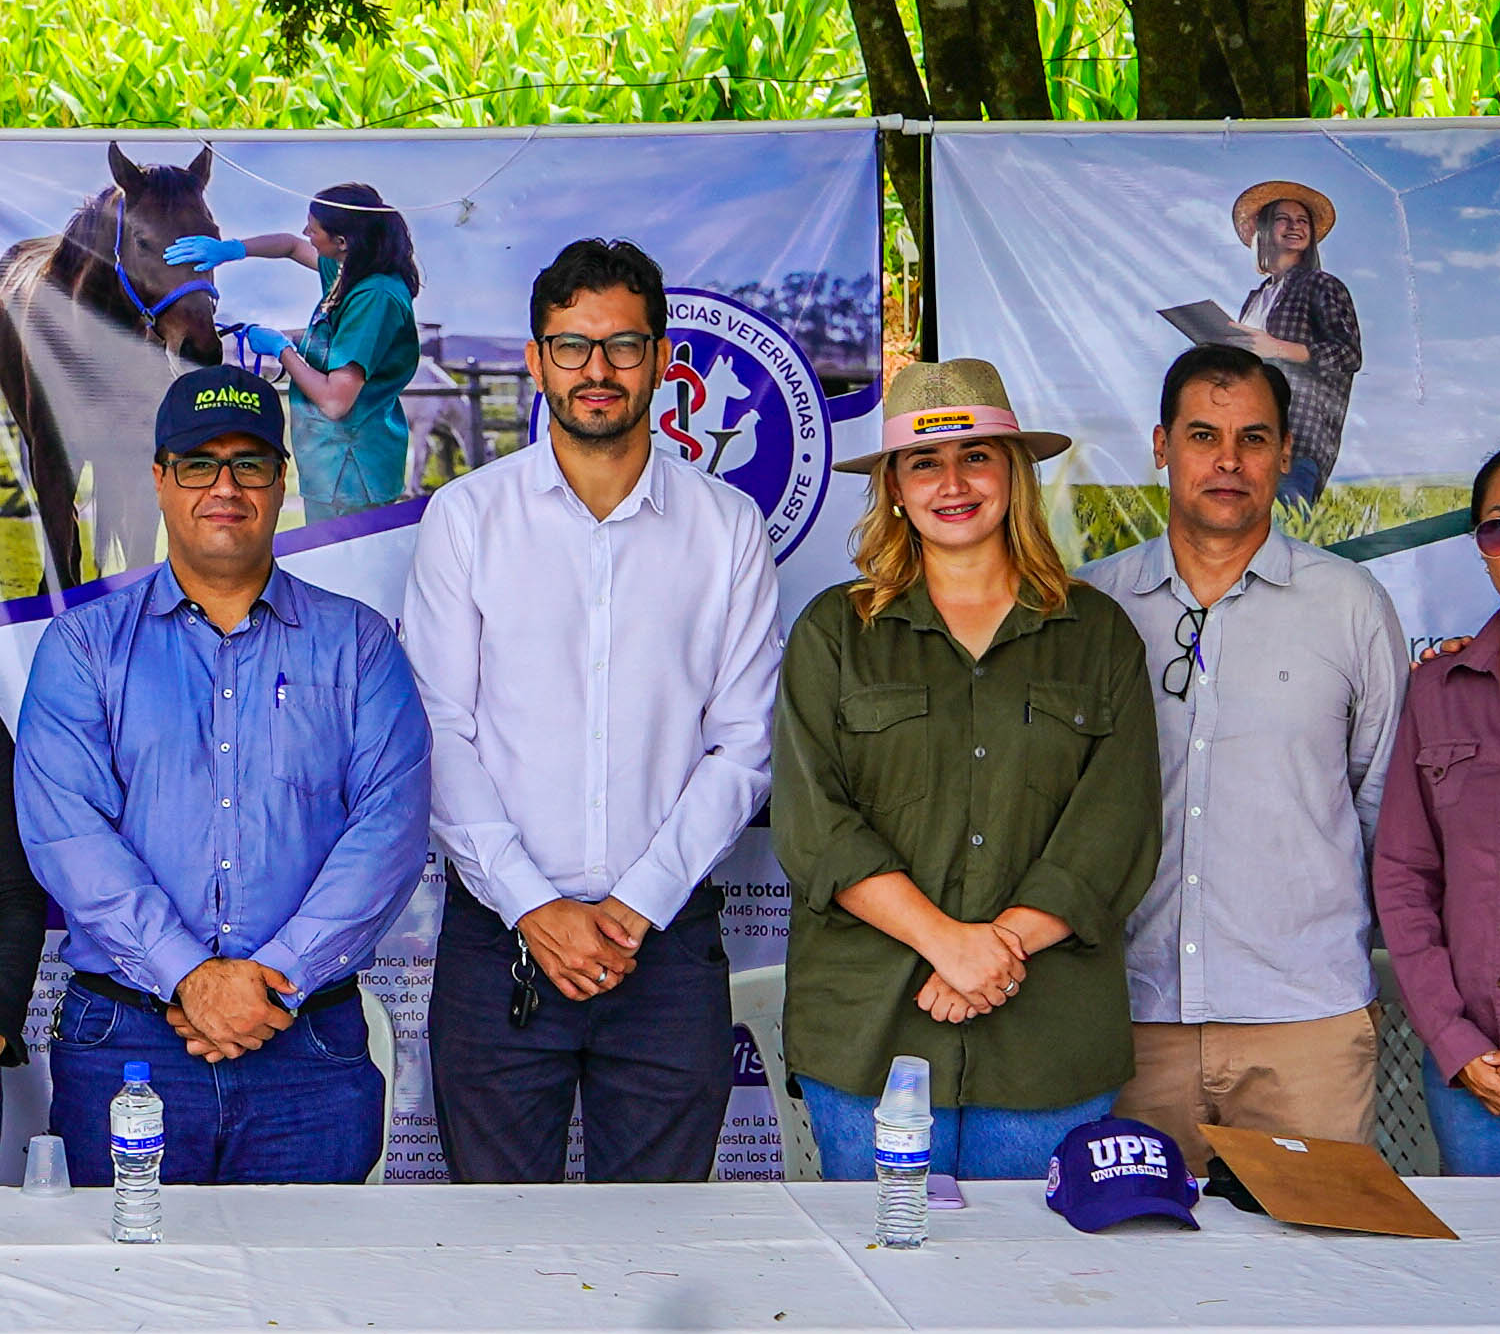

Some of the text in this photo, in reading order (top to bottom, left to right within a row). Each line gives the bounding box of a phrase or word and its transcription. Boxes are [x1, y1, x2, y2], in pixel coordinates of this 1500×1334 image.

[728, 316, 816, 440] VETERINARIAS
[782, 473, 812, 521] ESTE
[746, 882, 790, 898] total
[744, 924, 768, 936] 320
[400, 990, 417, 1003] de
[732, 1116, 765, 1127] en la
[718, 1151, 767, 1163] con los
[1088, 1135, 1167, 1168] UPE
[1091, 1164, 1168, 1183] UNIVERSIDAD
